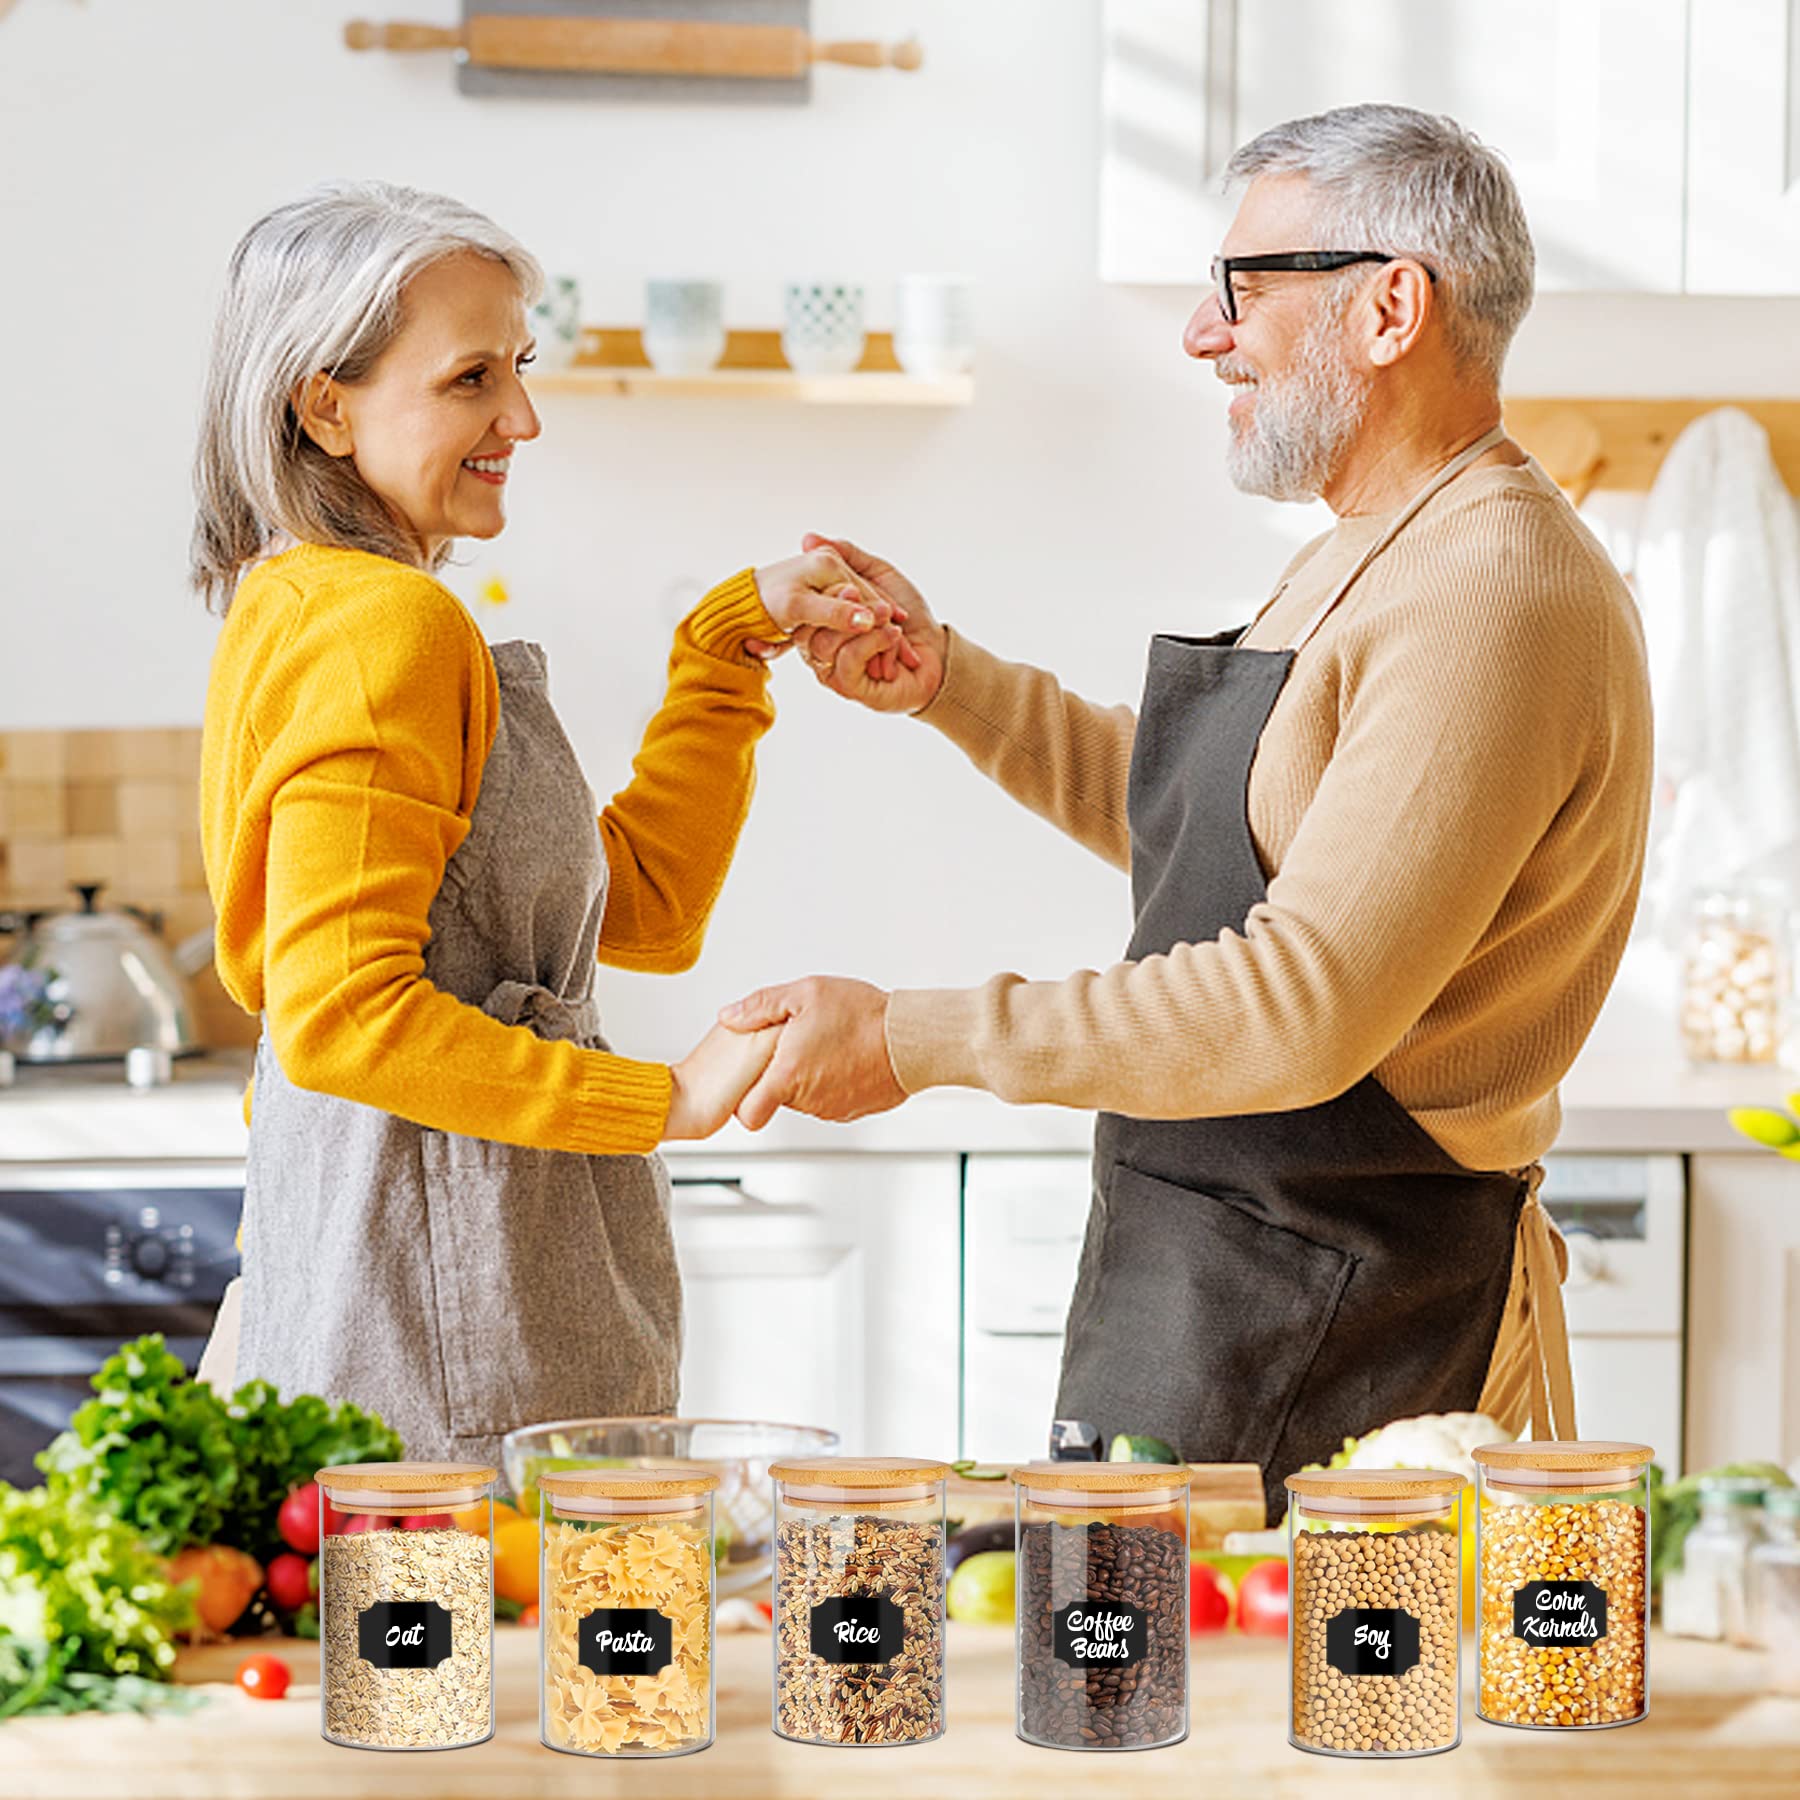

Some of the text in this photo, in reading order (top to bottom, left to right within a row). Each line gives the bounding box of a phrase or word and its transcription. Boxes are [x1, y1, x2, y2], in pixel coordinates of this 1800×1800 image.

[1535, 1589, 1587, 1611] Corn
[385, 1622, 425, 1647] Oat
[832, 1618, 881, 1644] Rice
[1066, 1609, 1135, 1642] Coffee
[1522, 1610, 1599, 1638] Kernels
[595, 1629, 656, 1653] Pasta
[1070, 1636, 1130, 1659] Beans
[1353, 1624, 1392, 1660] Soy
